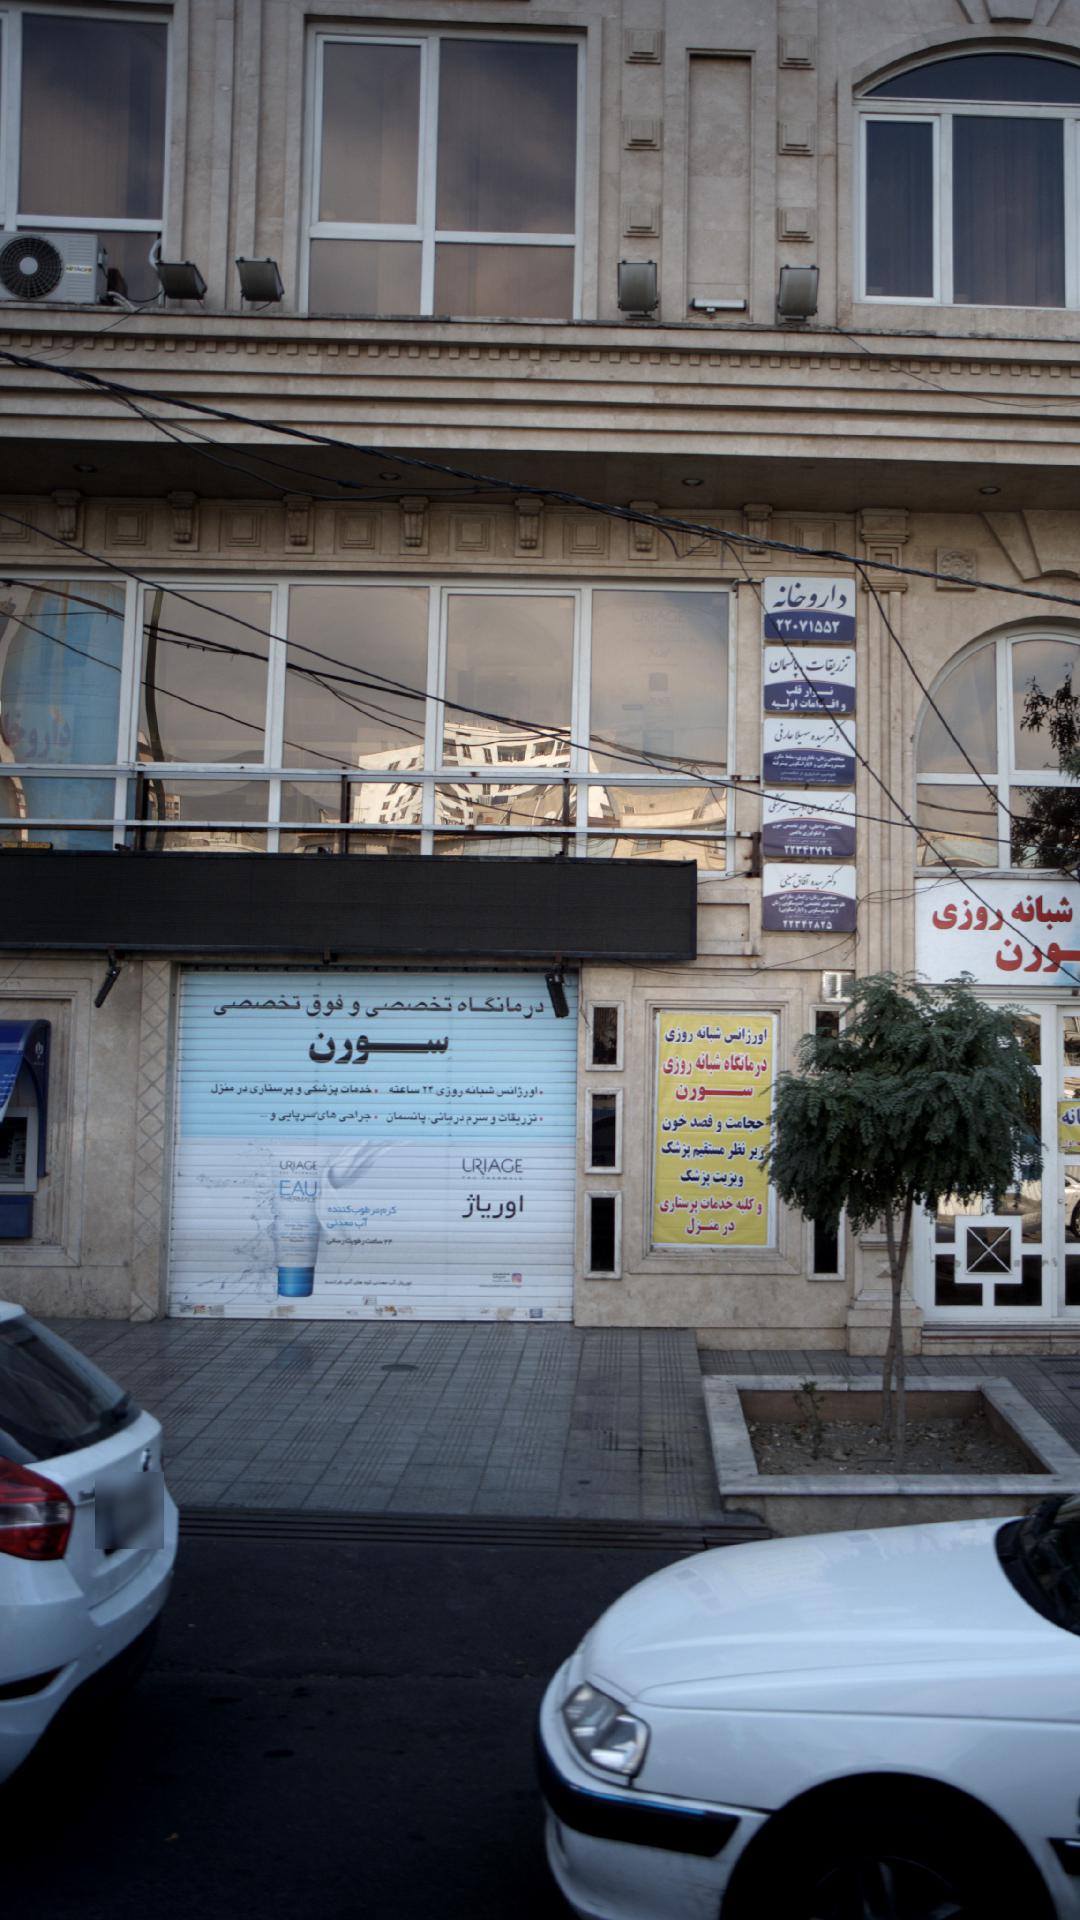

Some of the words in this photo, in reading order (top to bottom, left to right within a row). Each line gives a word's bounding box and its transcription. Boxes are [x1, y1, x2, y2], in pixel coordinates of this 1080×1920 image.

[772, 583, 847, 609] داروخانه
[806, 656, 851, 676] تزریقات
[786, 685, 802, 696] قلب
[771, 699, 797, 711] اولیه
[840, 703, 847, 711] و
[932, 900, 1004, 931] روزی
[1011, 895, 1073, 930] شبانه
[996, 939, 1080, 972] ورن
[213, 994, 301, 1016] تخصصی
[306, 994, 344, 1017] فوق
[348, 1000, 361, 1017] و
[366, 996, 452, 1018] تخصصی
[458, 997, 544, 1018] درمانگاه
[665, 1028, 693, 1043] روزی
[696, 1026, 721, 1043] شبانه
[724, 1026, 767, 1044] اورژانس
[309, 1032, 449, 1064] سورن
[663, 1056, 692, 1075] روزی
[695, 1053, 721, 1075] شبانه
[724, 1054, 767, 1077] درمانگاه
[210, 1083, 235, 1094] منزل
[237, 1086, 248, 1095] در
[249, 1084, 294, 1096] پرستاری
[295, 1087, 302, 1096] و
[304, 1085, 338, 1096] پزشکی
[340, 1084, 373, 1094] خدمات
[389, 1085, 420, 1095] ساعته
[496, 1086, 538, 1098] اورژانس
[675, 1084, 753, 1101] سورن
[269, 1112, 276, 1121] و
[278, 1109, 317, 1122] سرپایی
[317, 1110, 337, 1121] های
[338, 1110, 372, 1122] جراحی
[386, 1112, 427, 1124] پانسمان
[466, 1115, 489, 1125] سرم
[498, 1112, 538, 1125] تزریقات
[662, 1114, 687, 1131] خون
[690, 1114, 713, 1128] فصد
[716, 1120, 722, 1132] و
[725, 1116, 764, 1132] حجامت
[661, 1141, 691, 1158] پزشک
[693, 1142, 725, 1157] مستقیم
[727, 1142, 746, 1159] نظر
[749, 1146, 765, 1160] زیر
[279, 1161, 318, 1171] URIAGE
[462, 1158, 523, 1175] URIAGE
[680, 1169, 710, 1186] پزشک
[712, 1172, 744, 1187] ویزیت
[280, 1180, 318, 1197] EAU
[461, 1194, 523, 1218] اوریاژ
[659, 1195, 698, 1213] پرستاری
[700, 1197, 733, 1210] خدمات
[735, 1197, 754, 1213] کلیه
[757, 1203, 763, 1215] و
[326, 1219, 354, 1229] معدنی
[355, 1218, 368, 1230] آب
[686, 1217, 720, 1235] منزل
[722, 1221, 735, 1235] در
